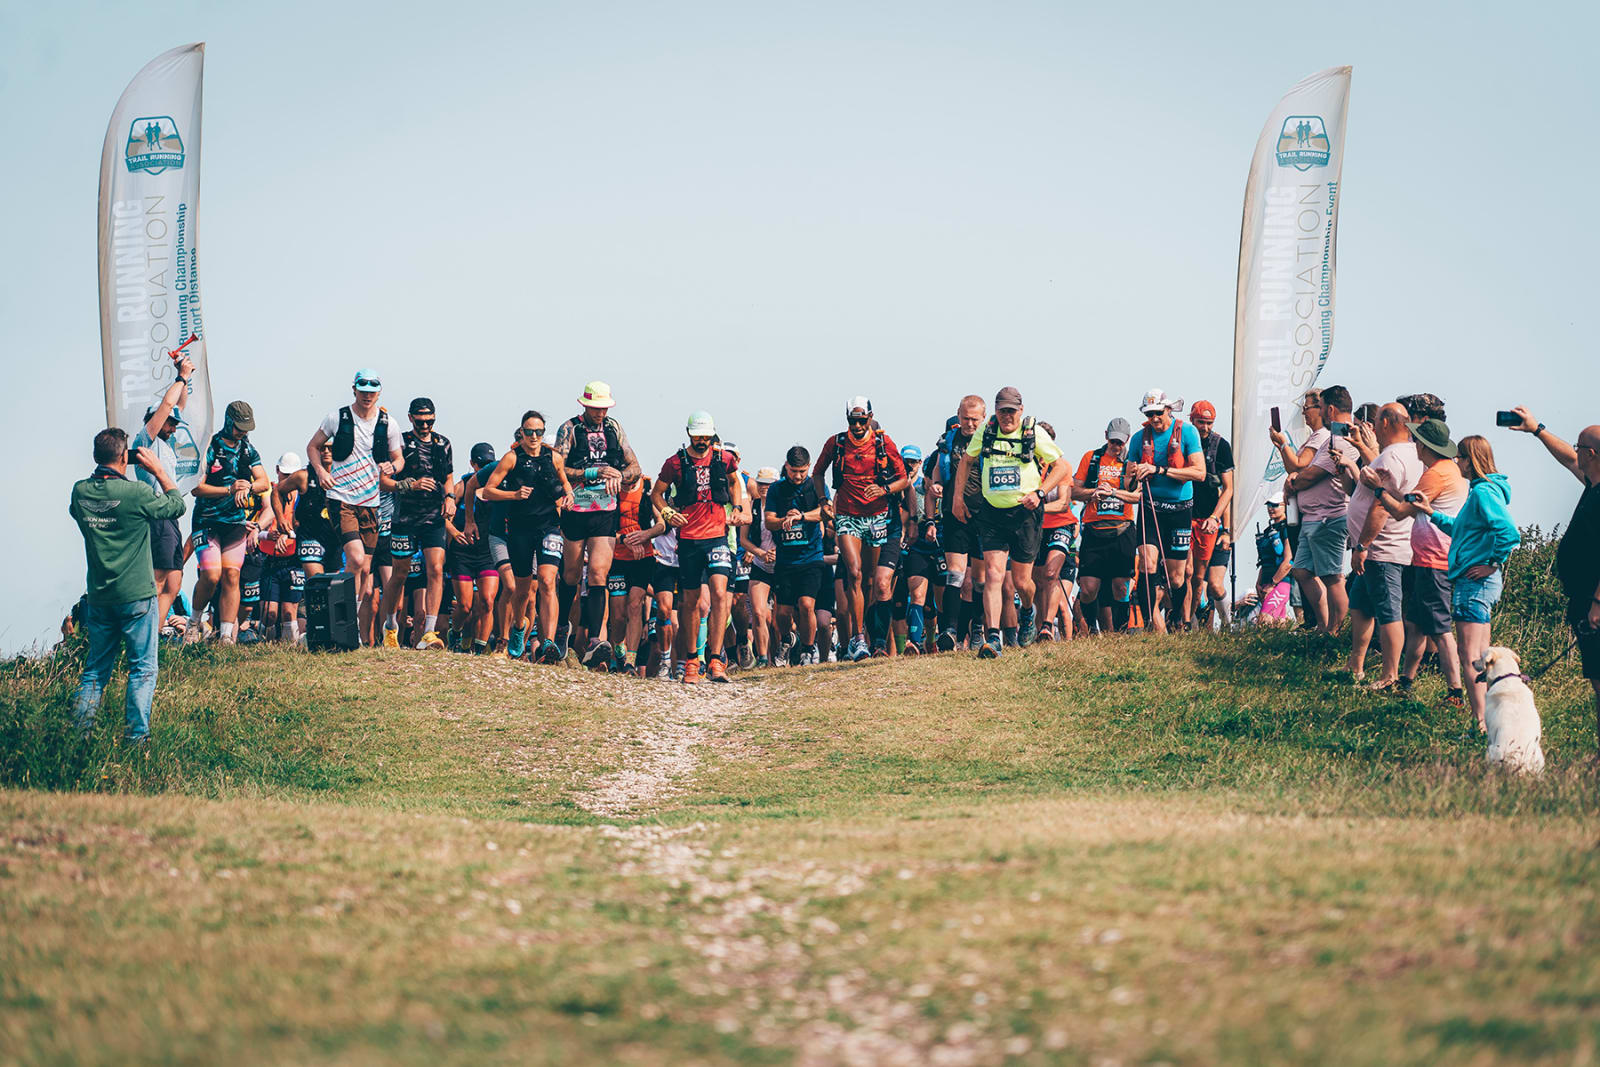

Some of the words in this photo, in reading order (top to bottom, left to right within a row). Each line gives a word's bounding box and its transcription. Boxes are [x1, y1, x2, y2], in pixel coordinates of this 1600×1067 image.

[128, 155, 148, 163] TRAIL
[1325, 182, 1338, 216] Event
[112, 200, 149, 322] RUNNING
[175, 203, 187, 291] Championship
[1258, 186, 1298, 320] RUNNING
[1318, 219, 1332, 307] Championship
[189, 247, 200, 303] Distance
[177, 294, 190, 346] Running
[1318, 310, 1333, 361] Running
[119, 328, 151, 409] TRAIL
[1257, 327, 1292, 416] TRAIL
[993, 475, 1015, 484] 065
[1101, 502, 1120, 510] 045
[300, 547, 321, 556] 002
[392, 541, 410, 550] 005
[785, 531, 803, 540] 120
[608, 581, 627, 590] 099
